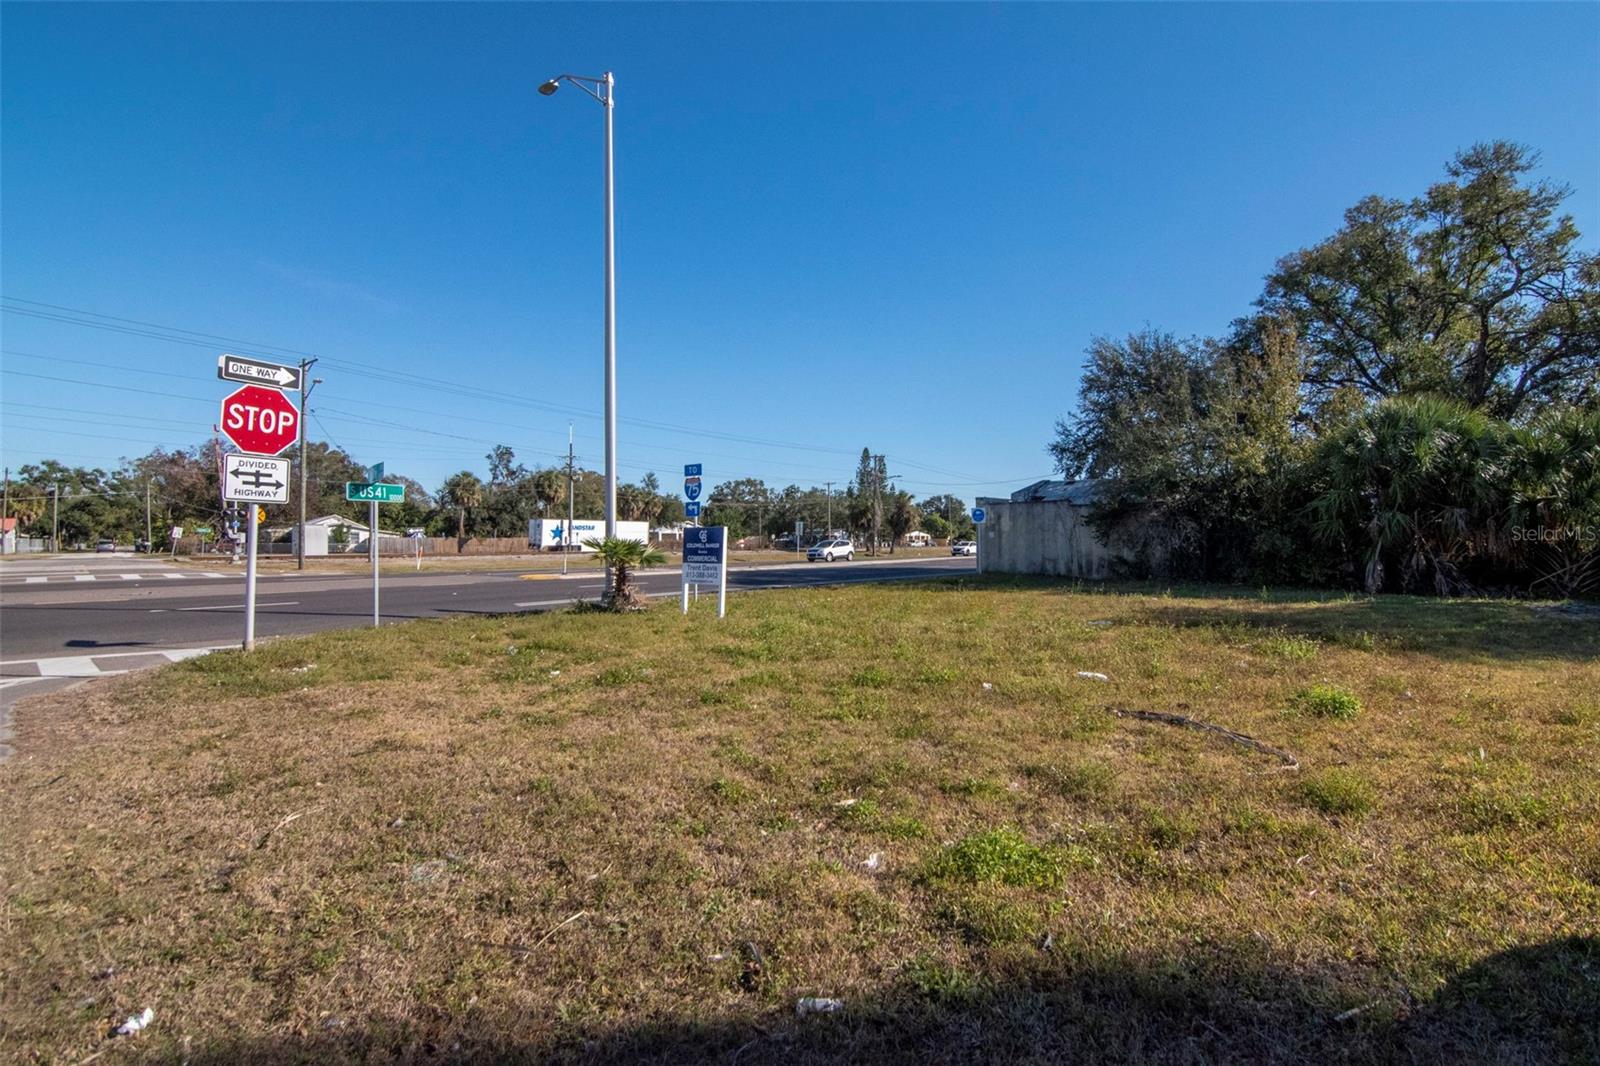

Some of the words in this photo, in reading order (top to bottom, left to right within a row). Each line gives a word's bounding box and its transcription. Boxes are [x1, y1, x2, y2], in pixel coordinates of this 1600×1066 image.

[231, 363, 253, 375] ONE
[256, 367, 277, 379] WAY
[227, 403, 295, 435] STOP
[238, 460, 277, 470] DIVIDED
[688, 466, 698, 474] TO
[234, 488, 278, 498] HIGHWAY
[687, 483, 700, 497] 75
